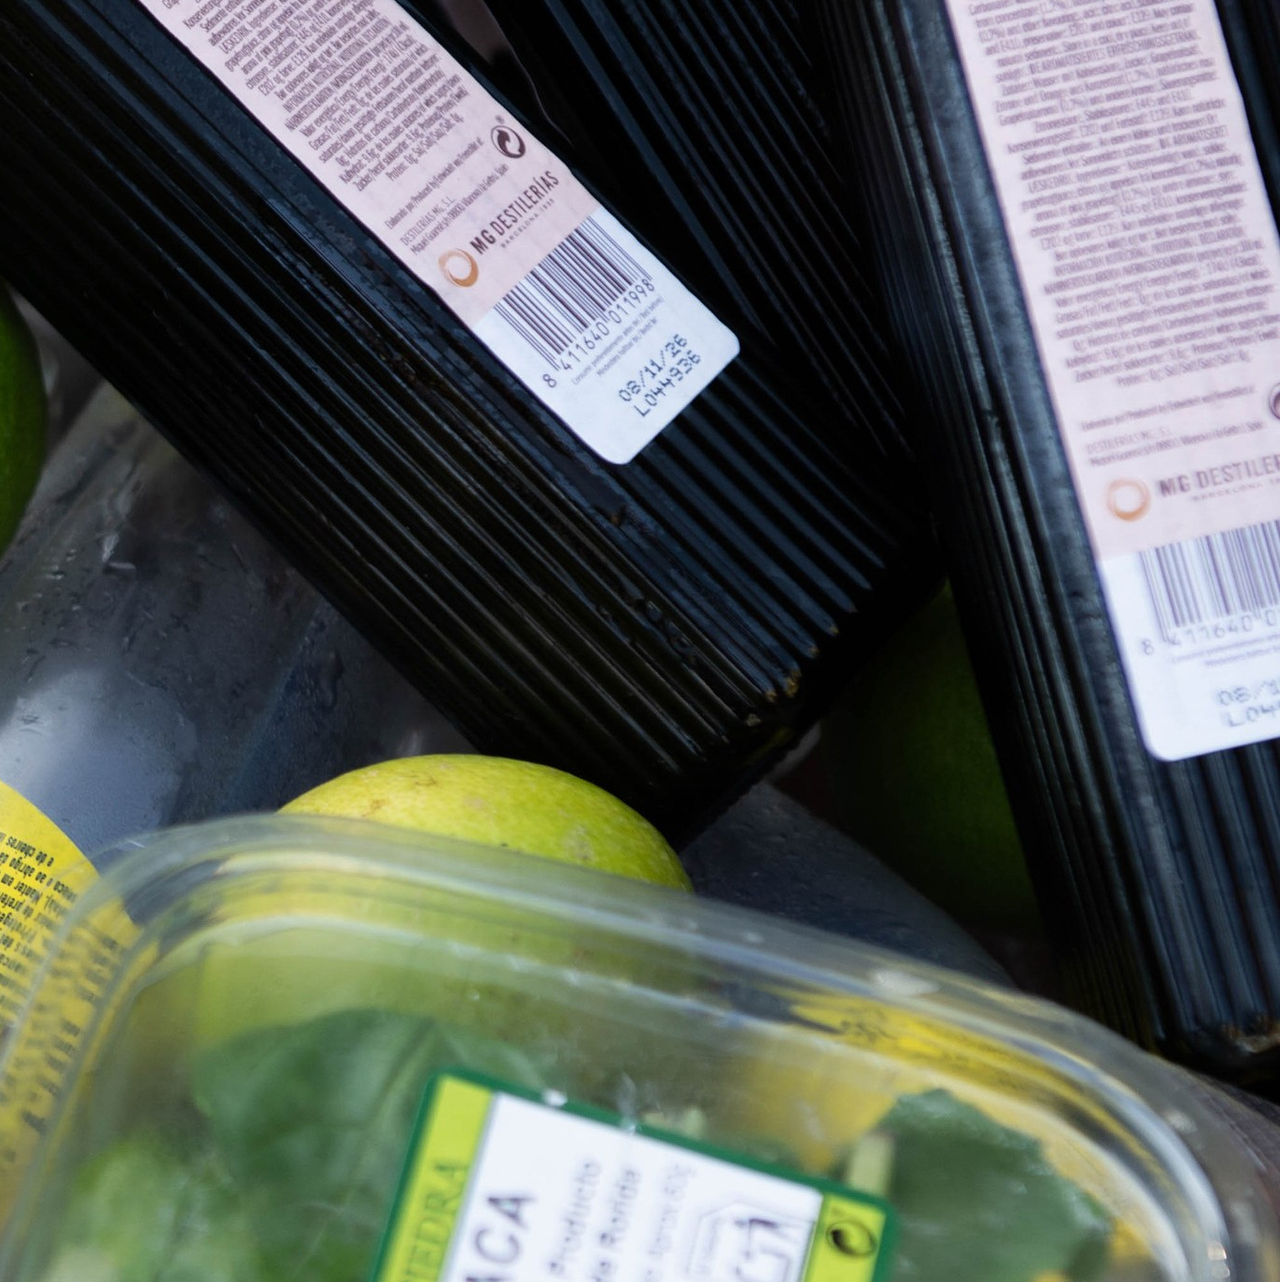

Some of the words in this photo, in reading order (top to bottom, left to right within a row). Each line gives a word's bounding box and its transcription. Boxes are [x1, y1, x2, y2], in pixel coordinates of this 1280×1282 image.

[470, 229, 496, 255] MG
[489, 170, 559, 237] DESTILERÍAS
[400, 212, 436, 247] DESTILERÍAS
[500, 213, 539, 249] BARCELONA
[542, 373, 557, 389] 8
[560, 321, 610, 371] 411640
[608, 278, 655, 324] 011998
[618, 334, 688, 402] 08/11/26
[1159, 476, 1187, 496] MG
[6, 836, 37, 859] cheiros
[35, 851, 48, 865] de
[9, 857, 36, 878] abrigo
[47, 857, 54, 867] e
[1, 874, 14, 887] em
[35, 871, 47, 884] ao
[546, 1155, 604, 1280] Producto
